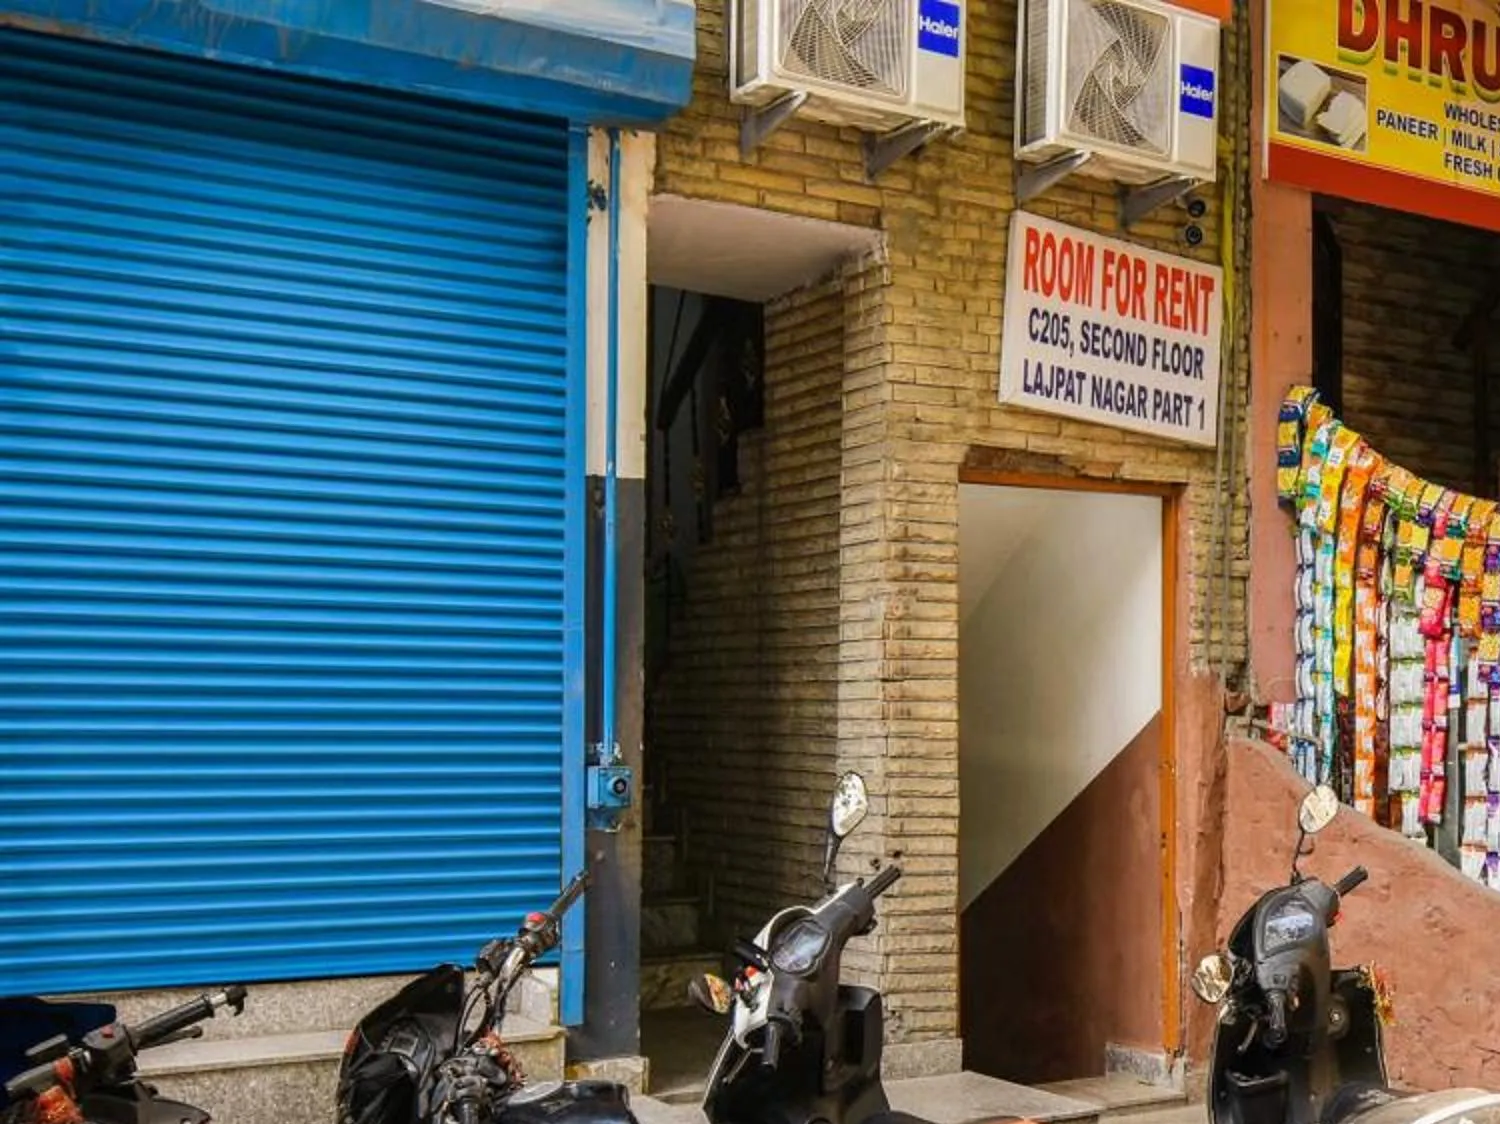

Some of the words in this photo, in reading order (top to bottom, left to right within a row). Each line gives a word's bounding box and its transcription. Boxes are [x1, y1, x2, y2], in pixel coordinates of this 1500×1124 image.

[919, 15, 959, 40] Haier
[1181, 80, 1214, 102] Haier
[1377, 109, 1438, 141] PANEER
[1451, 131, 1487, 153] MILK
[1444, 153, 1492, 180] FRESH
[1023, 227, 1093, 312] ROOM
[1102, 249, 1148, 321] FOR
[1154, 264, 1215, 336] RENT
[1028, 307, 1075, 358] C205,
[1082, 323, 1147, 368] SECOND
[1153, 338, 1204, 380] FLOOR
[1023, 358, 1086, 404] LAJPAT
[1091, 378, 1148, 419] NAGAR
[1154, 390, 1193, 428] PART
[1198, 400, 1205, 430] 1
